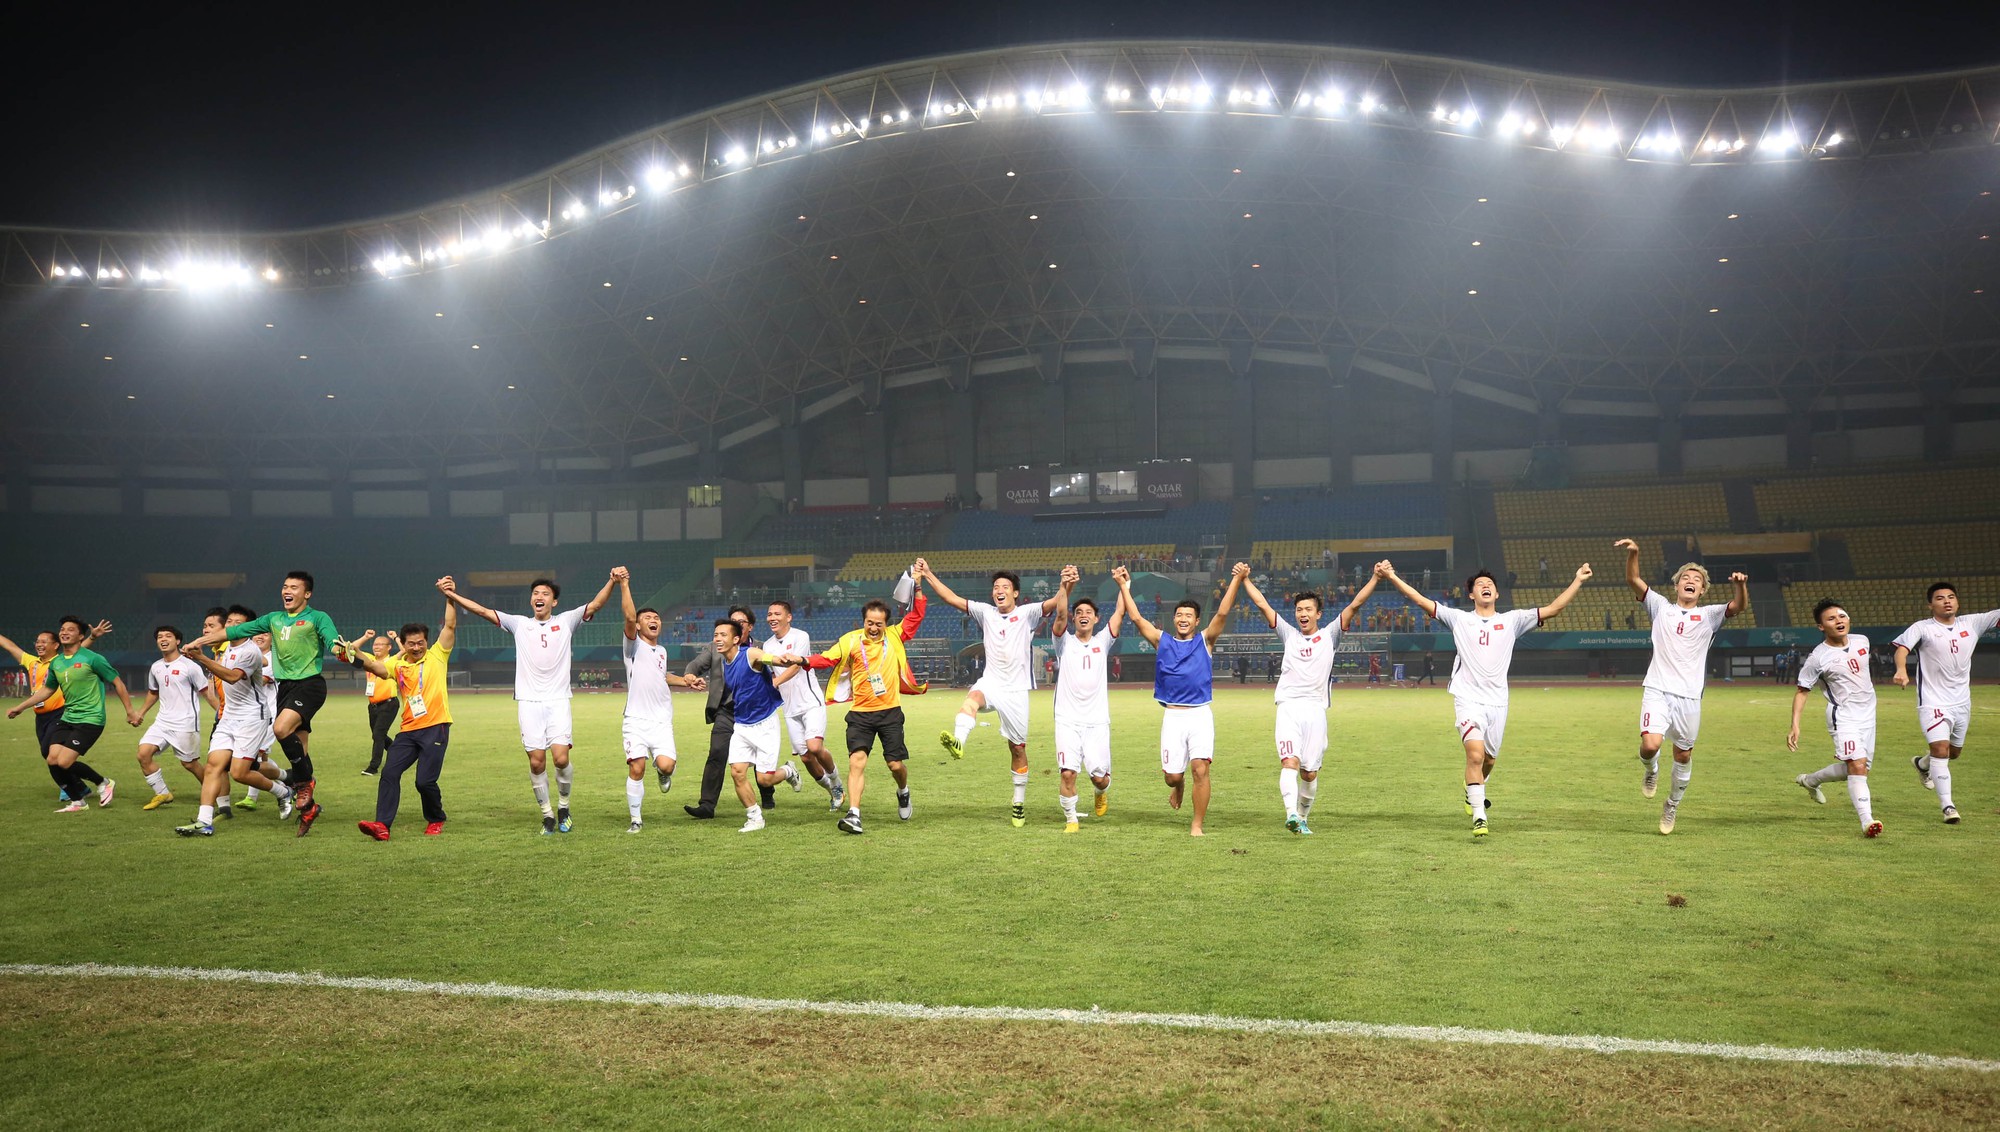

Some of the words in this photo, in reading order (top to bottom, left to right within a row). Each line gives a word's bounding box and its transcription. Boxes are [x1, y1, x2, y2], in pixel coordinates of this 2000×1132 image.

[1006, 489, 1039, 500] QATAR
[1147, 483, 1182, 494] QATAR
[1677, 621, 1684, 635] 8
[541, 634, 548, 648] 5
[1479, 630, 1489, 646] 21
[1579, 637, 1606, 645] Jakarta
[1607, 637, 1647, 645] Palembang
[1949, 639, 1959, 654] 15
[1846, 659, 1860, 674] 19
[165, 675, 170, 687] 9
[1643, 713, 1650, 727] 8
[1279, 741, 1293, 755] 20
[1844, 740, 1856, 756] 19
